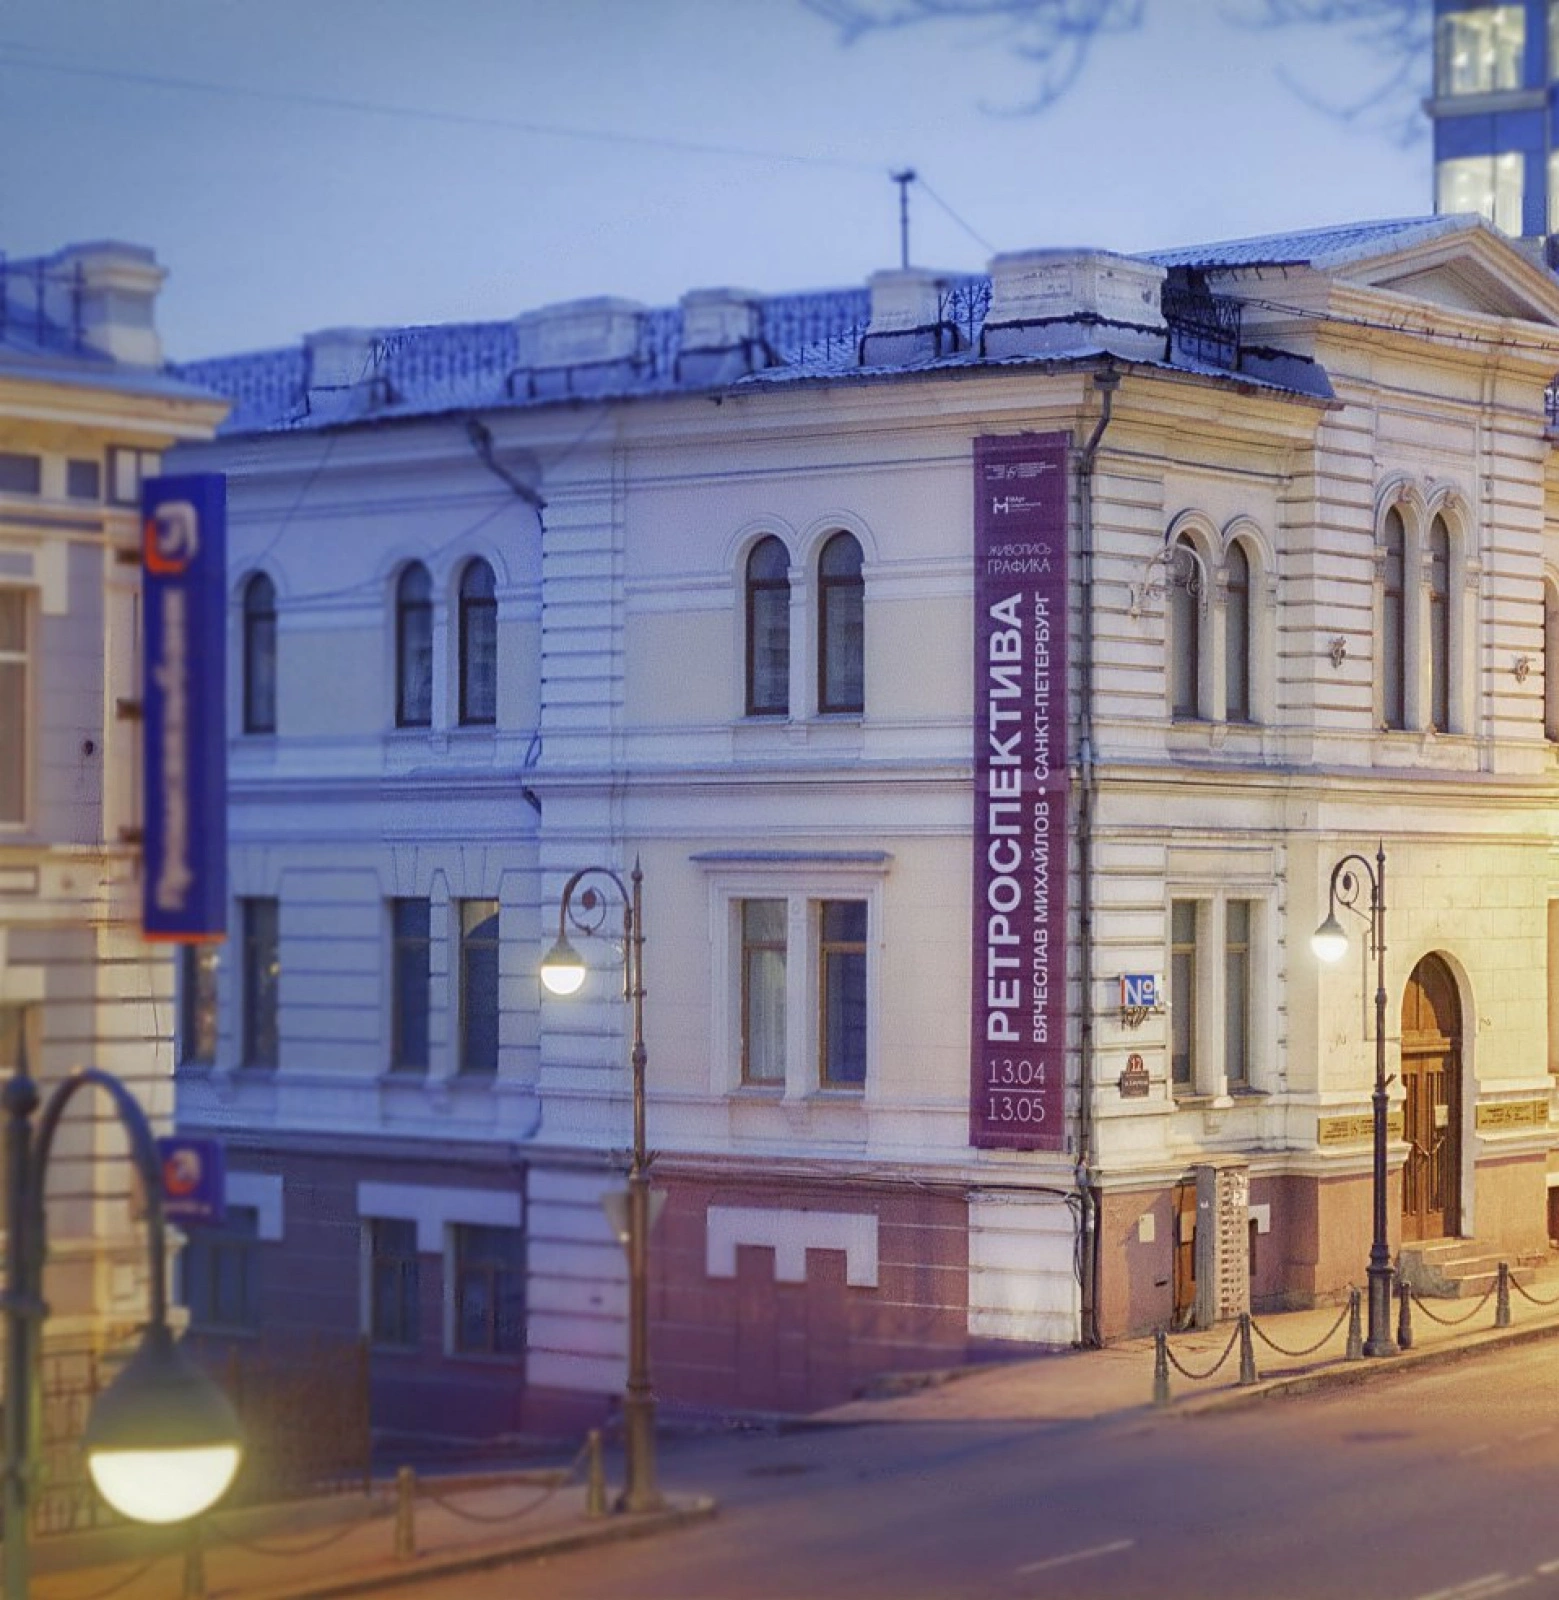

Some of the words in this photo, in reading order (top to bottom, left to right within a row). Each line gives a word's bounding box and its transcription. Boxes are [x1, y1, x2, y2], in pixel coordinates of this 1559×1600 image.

[987, 558, 1051, 575] ГРАФИКА
[988, 543, 1052, 556] ЖИВОПИСЬ
[1034, 591, 1050, 780] САНКТ-ПЕТЕРБУРГ
[987, 592, 1022, 1042] РЕТРОСПЕКТИВА
[1030, 801, 1049, 923] МИХАЙЛОВ
[1033, 929, 1048, 1043] ВЯЧЕСЛАВ
[988, 1060, 1045, 1084] 13.04
[988, 1097, 1045, 1122] 13.05
